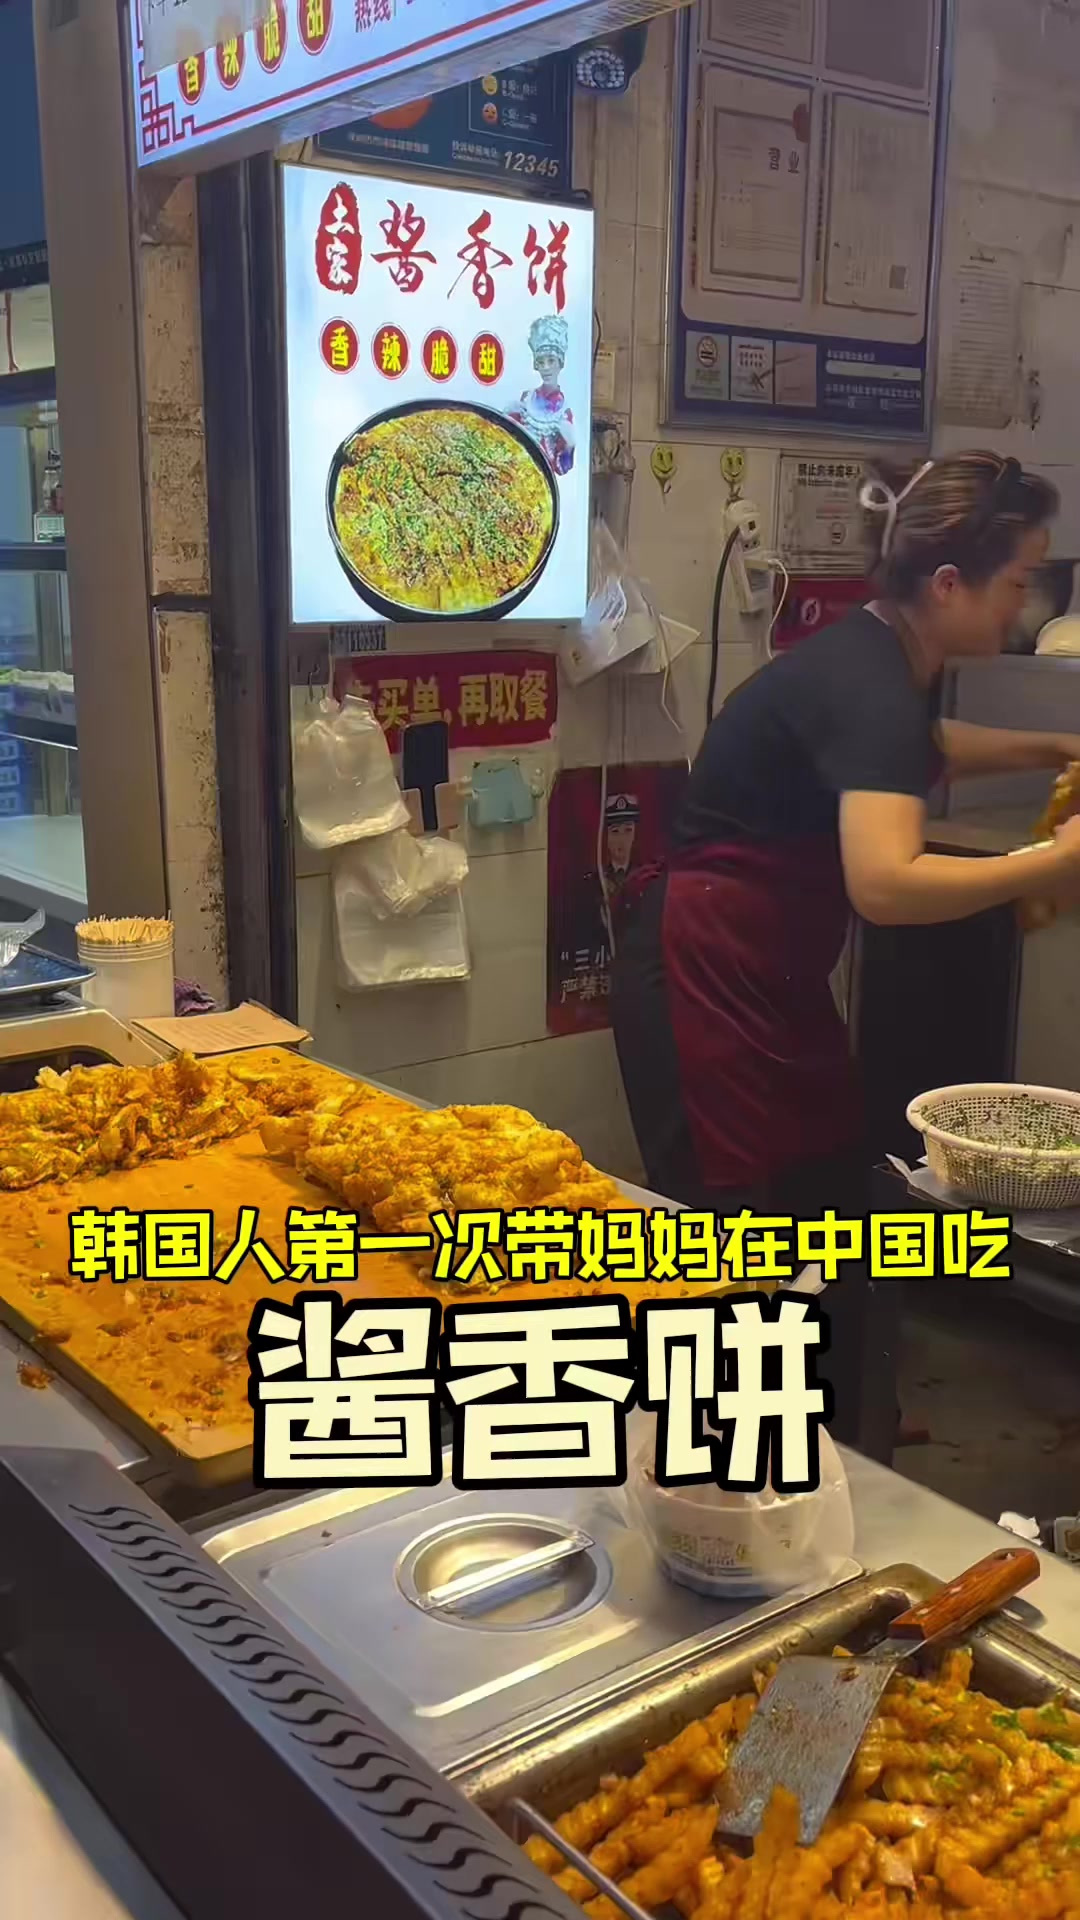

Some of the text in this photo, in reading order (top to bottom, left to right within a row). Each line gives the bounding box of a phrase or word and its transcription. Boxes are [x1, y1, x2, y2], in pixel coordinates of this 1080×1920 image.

[504, 151, 560, 177] 12345
[325, 193, 356, 285] 土家
[370, 199, 571, 314] 酱香饼
[330, 326, 497, 377] 香辣脆甜
